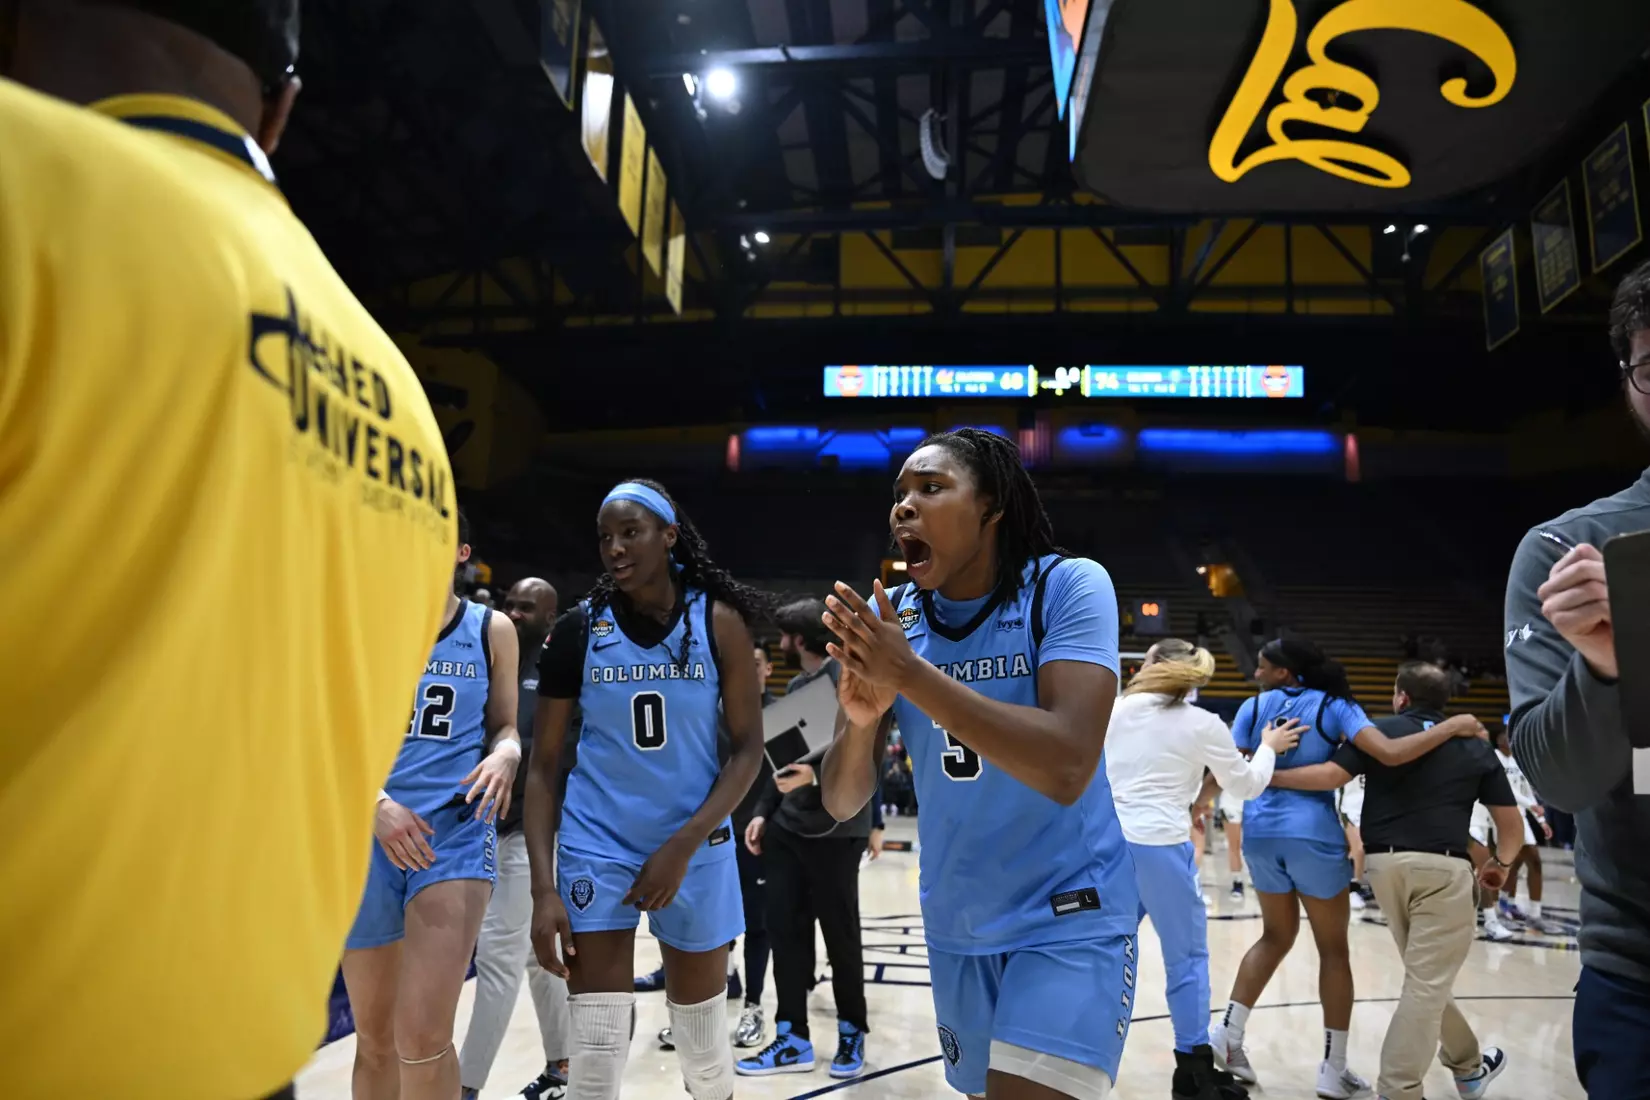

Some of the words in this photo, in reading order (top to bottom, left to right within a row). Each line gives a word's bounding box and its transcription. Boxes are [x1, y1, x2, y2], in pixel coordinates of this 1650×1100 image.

[1209, 0, 1517, 189] Cal
[422, 659, 478, 679] MBIA
[590, 663, 706, 684] COLUMBIA
[935, 652, 1032, 683] MBIA
[405, 682, 457, 740] 2
[630, 690, 668, 751] 0
